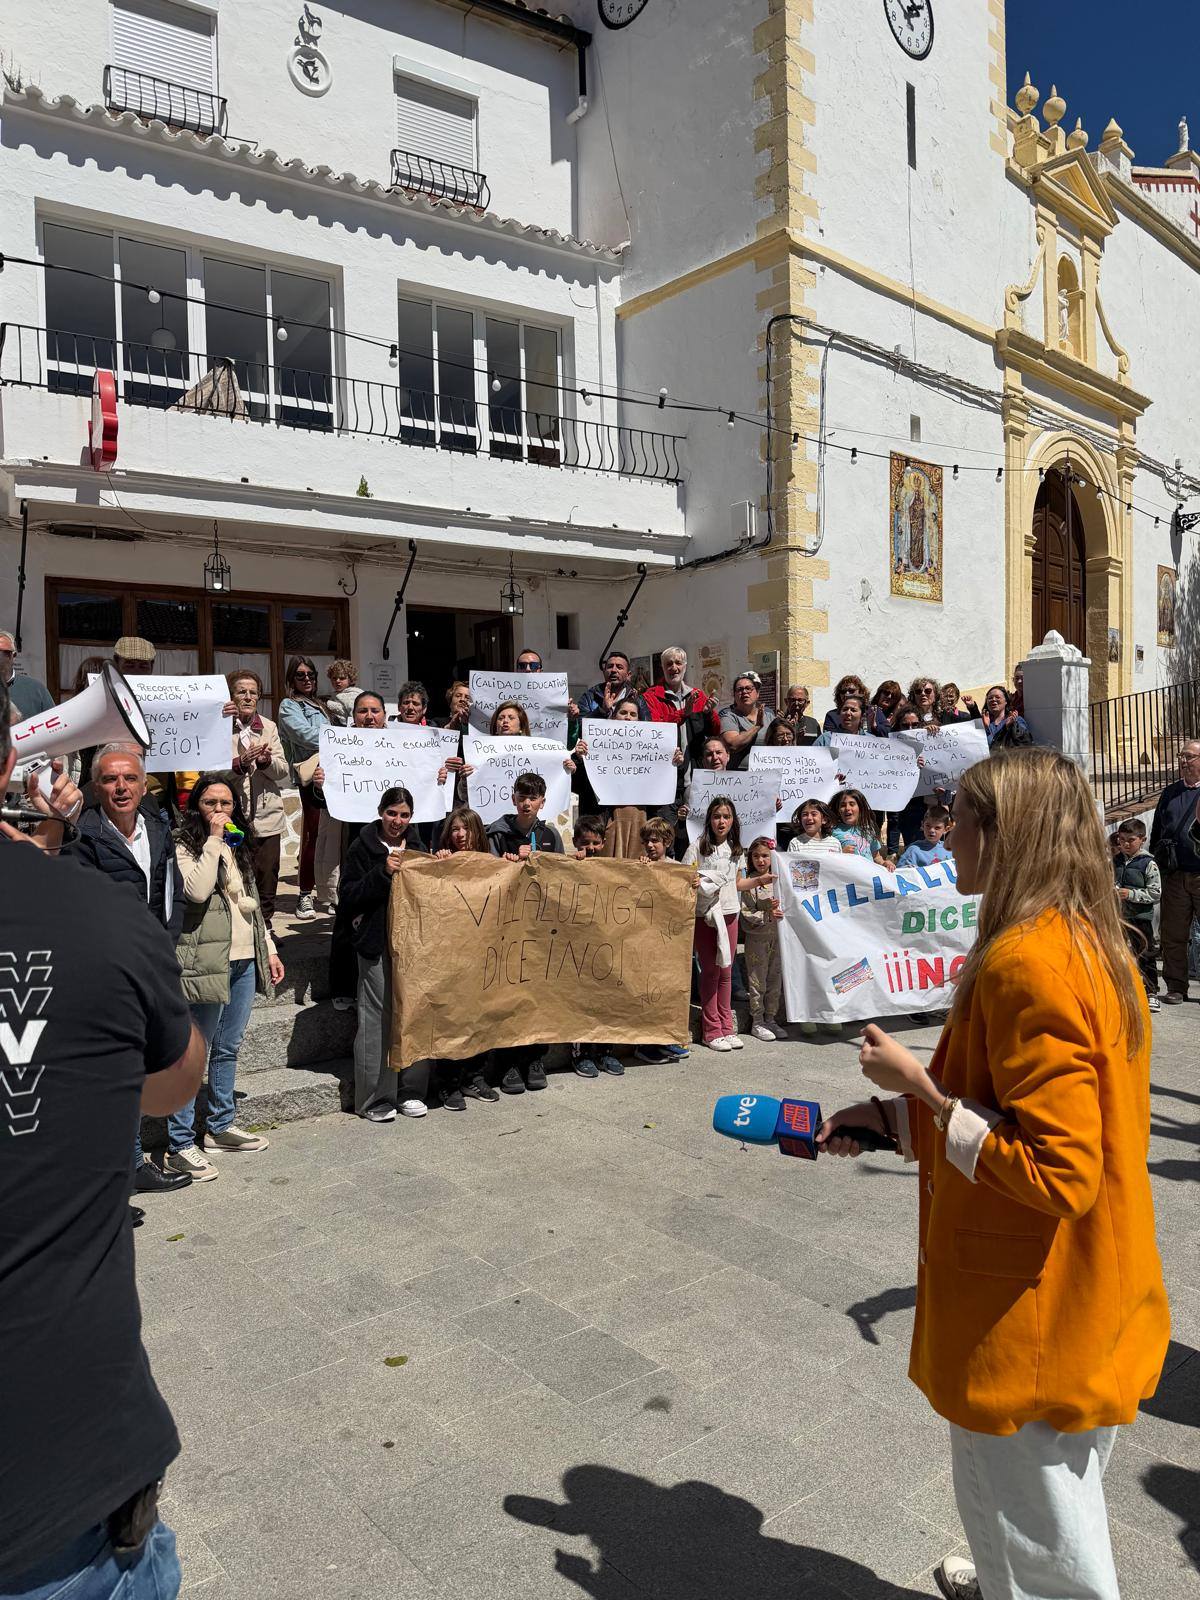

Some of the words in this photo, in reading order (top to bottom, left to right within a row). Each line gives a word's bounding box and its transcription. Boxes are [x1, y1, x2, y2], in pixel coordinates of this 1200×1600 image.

[891, 10, 897, 21] 8
[898, 25, 903, 36] 7
[920, 31, 925, 41] 4
[907, 36, 912, 47] 6
[915, 38, 920, 48] 5
[204, 683, 213, 691] A
[498, 691, 529, 700] CLASES
[145, 712, 175, 723] ENGA
[183, 711, 199, 721] EN
[165, 727, 178, 736] SU
[588, 724, 643, 738] EDUCACIÓN
[651, 730, 665, 740] DE
[324, 728, 364, 747] Pueblo
[374, 737, 396, 749] sin
[402, 738, 441, 750] escuela
[592, 738, 632, 750] CALIDAD
[636, 741, 660, 750] PARA
[472, 740, 498, 754] POR
[504, 743, 524, 752] UNA
[334, 752, 373, 767] Pueblo
[385, 758, 408, 767] sin
[607, 753, 623, 762] LAS
[630, 752, 670, 762] FAMILIAS
[597, 765, 608, 774] SE
[614, 766, 652, 775] QUEDEN
[794, 766, 820, 776] MISMO
[858, 769, 869, 777] LA
[800, 777, 809, 785] DE
[902, 902, 977, 934] DICE
[480, 935, 537, 990] DICE
[733, 1096, 757, 1127] tve
